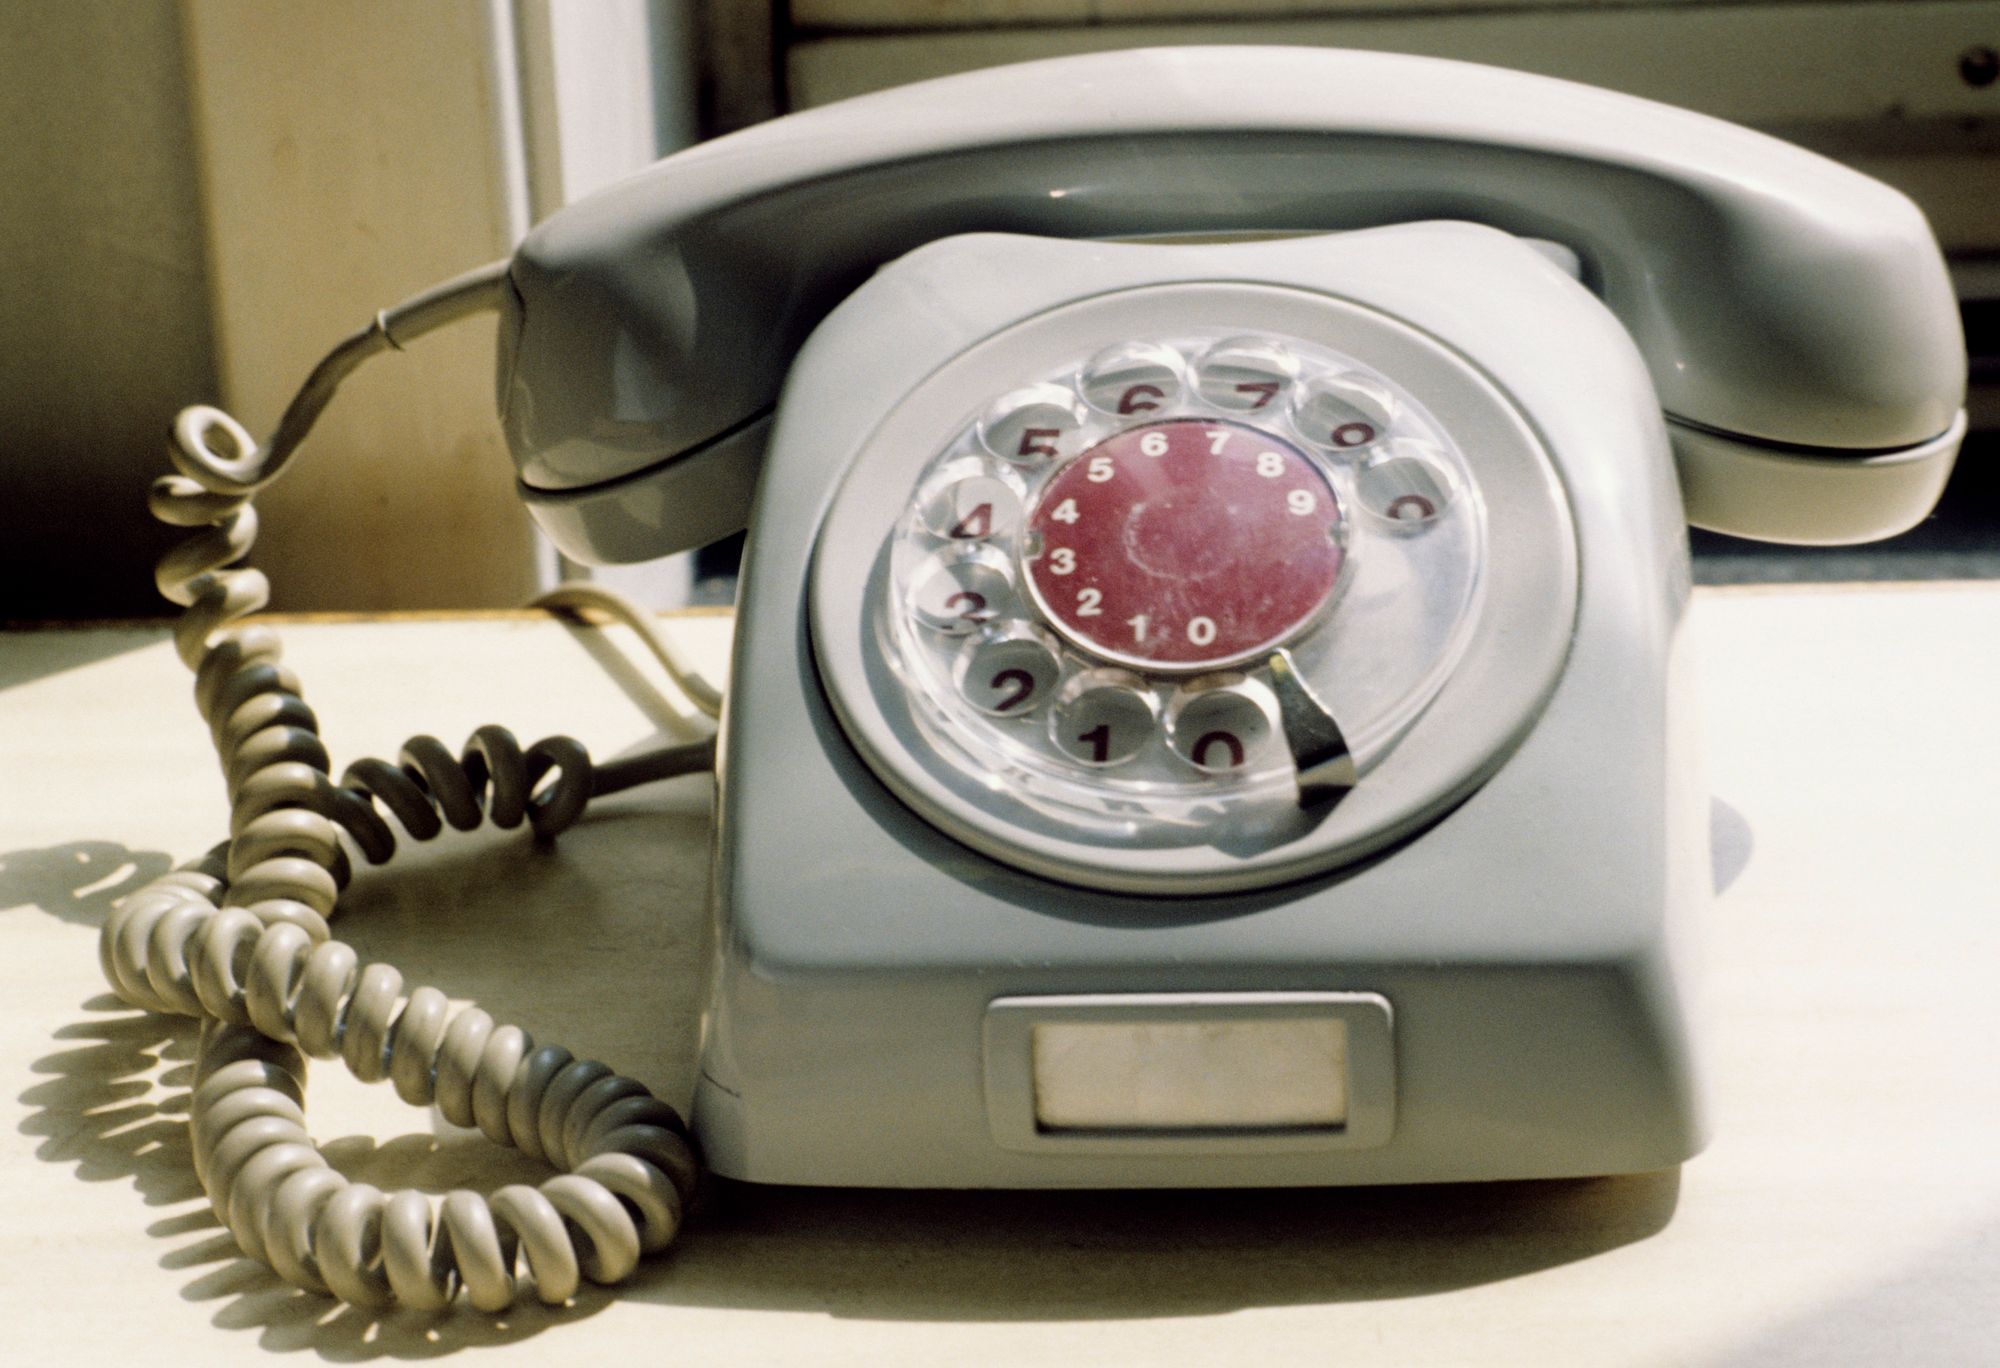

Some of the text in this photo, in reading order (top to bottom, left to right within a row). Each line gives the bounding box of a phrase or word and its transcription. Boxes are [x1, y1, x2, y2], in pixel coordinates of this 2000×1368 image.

[1235, 382, 1279, 408] 7
[1018, 428, 1060, 457] 5
[1140, 432, 1169, 457] 6
[1205, 431, 1231, 455] 7
[1087, 457, 1115, 482] 5
[1256, 452, 1285, 478] 8
[1051, 499, 1080, 524] 4
[1287, 489, 1316, 515] 9
[951, 503, 992, 539] 4
[1049, 548, 1076, 575] 3
[1076, 588, 1103, 616] 2
[1127, 615, 1150, 642] 1
[1187, 616, 1217, 646] 0
[991, 668, 1034, 712] 2
[1078, 725, 1110, 762] 1
